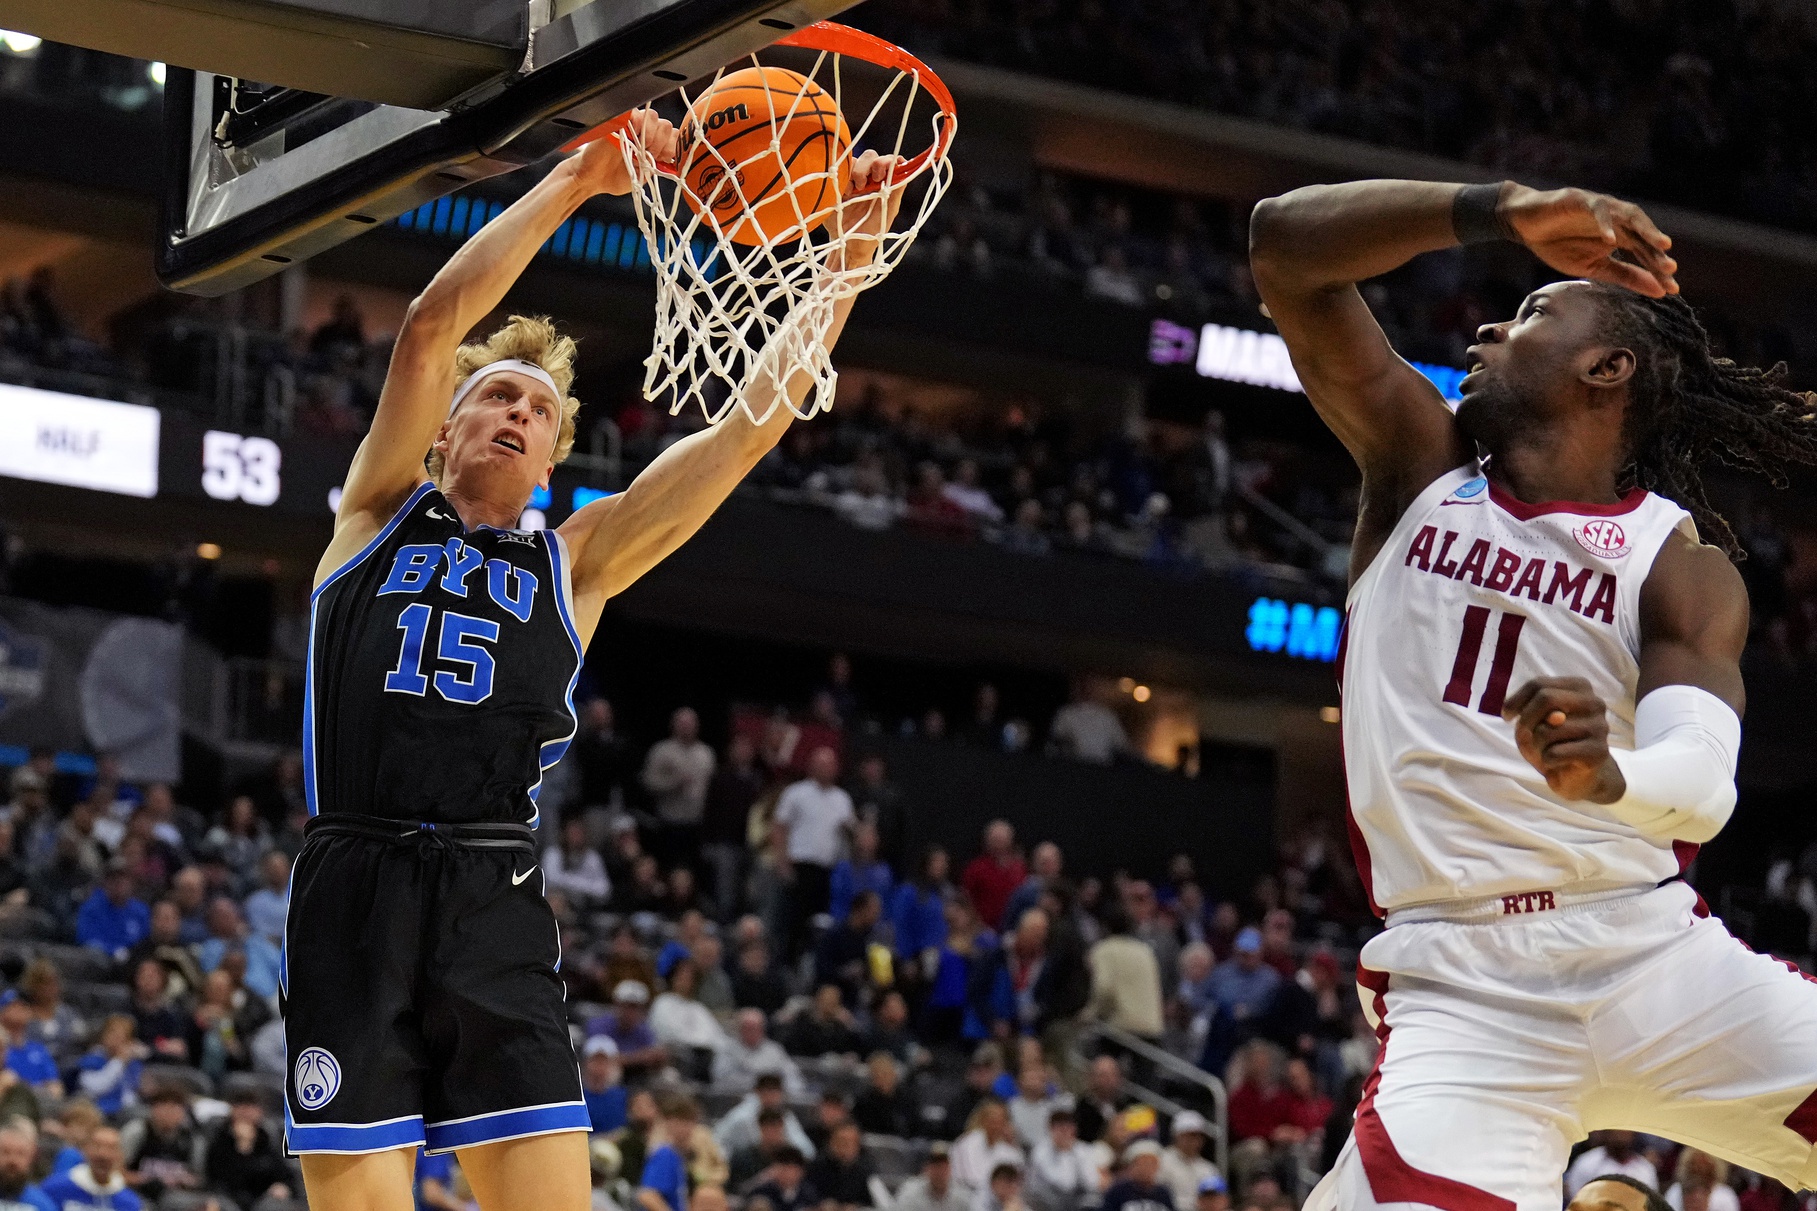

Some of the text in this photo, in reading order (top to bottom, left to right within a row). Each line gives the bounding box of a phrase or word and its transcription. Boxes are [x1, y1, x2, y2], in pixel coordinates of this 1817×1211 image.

[676, 103, 750, 171] ilon
[201, 429, 281, 507] 53
[1585, 521, 1623, 550] SEC
[376, 537, 538, 622] BYU
[1405, 525, 1617, 625] ALABAMA
[384, 602, 500, 705] 15
[1245, 597, 1341, 662] #M
[1442, 604, 1527, 718] 11
[1501, 890, 1556, 915] RTR
[305, 1085, 321, 1100] Y
